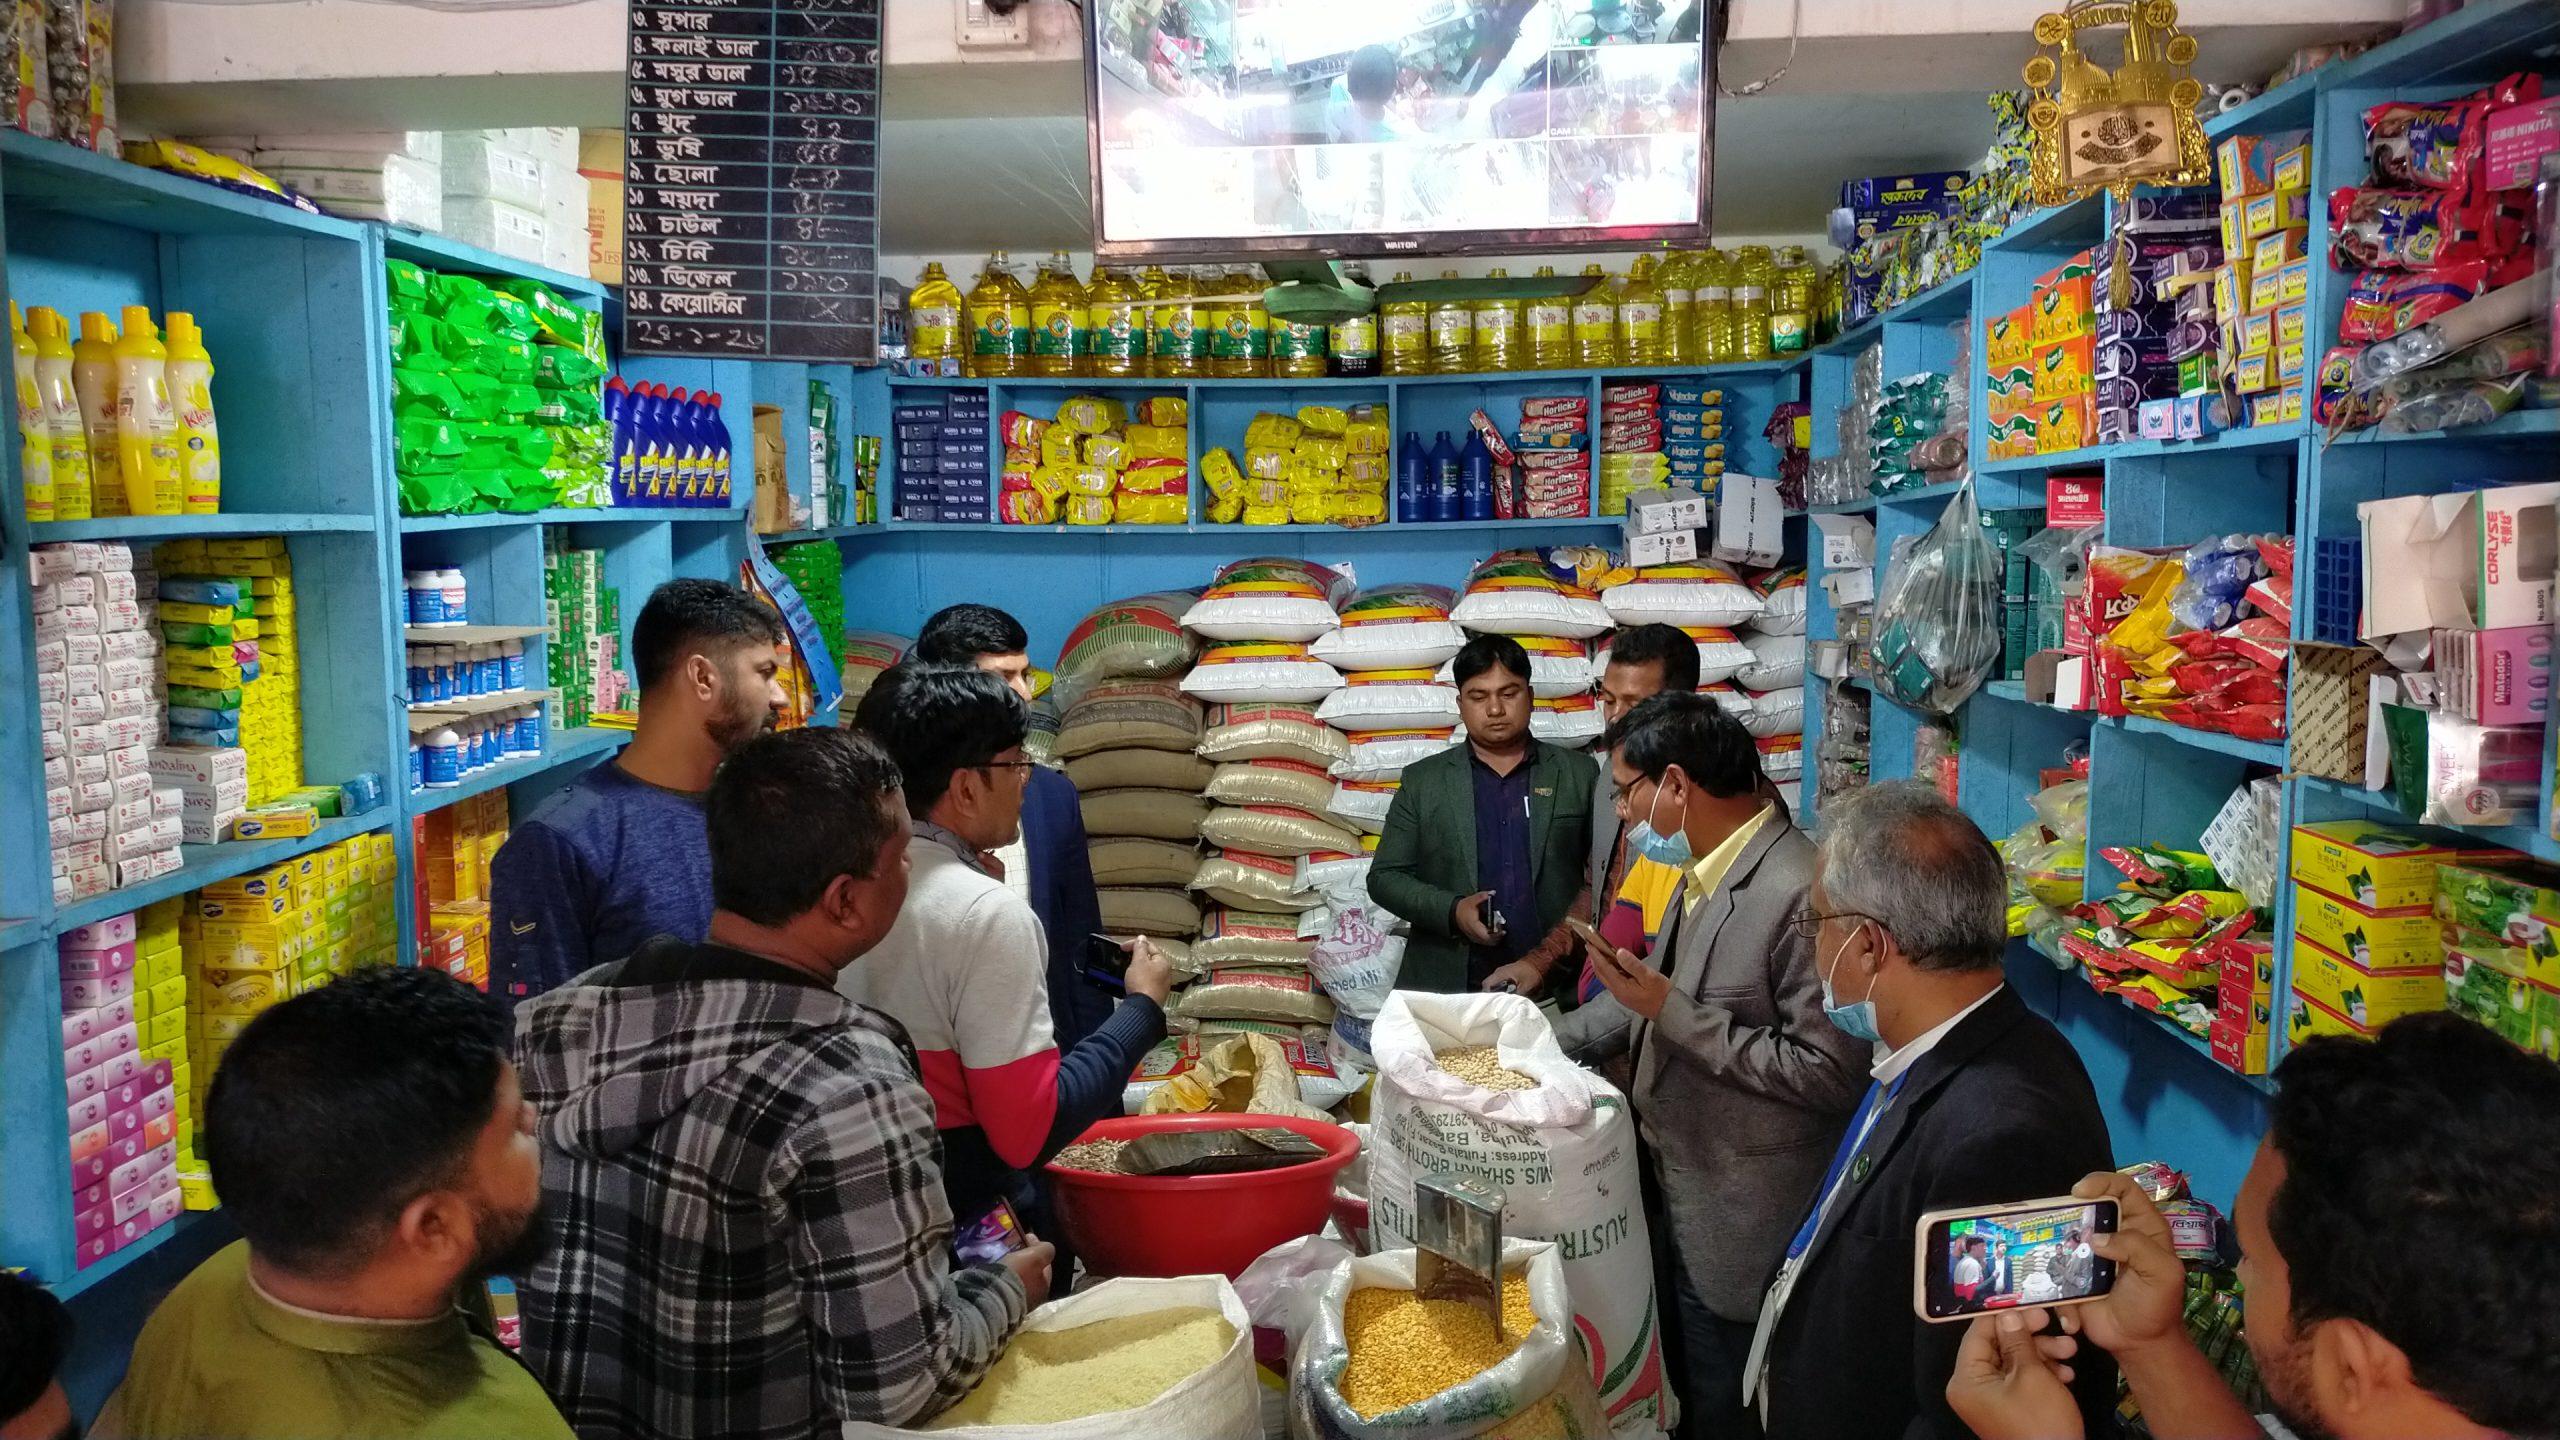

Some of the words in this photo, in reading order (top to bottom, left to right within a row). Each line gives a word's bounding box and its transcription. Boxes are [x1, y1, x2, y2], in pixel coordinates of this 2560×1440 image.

[657, 11, 713, 32] সুপার
[651, 35, 713, 58] কলাই
[716, 39, 759, 57] ডাল
[653, 62, 703, 83] মসুর
[707, 64, 751, 82] ডাল
[654, 88, 691, 109] মুগ
[694, 90, 737, 108] ডাল
[657, 113, 696, 134] খুদ
[2516, 118, 2553, 137] NIKITA
[656, 137, 704, 161] ভুষি
[654, 165, 720, 184] ছোলা
[657, 190, 720, 210] ময়দা
[658, 213, 722, 235] চাউল
[660, 239, 714, 262] চিনি
[660, 265, 737, 289] ডিজেল
[660, 291, 747, 315] কেরোসিন
[1614, 387, 1647, 402] Horlicks
[1544, 401, 1577, 416] Horlicks
[1614, 409, 1647, 422] Horlicks
[1541, 421, 1573, 434] Horlicks
[1619, 423, 1651, 437] Horlicks
[1615, 437, 1647, 451] Horlicks
[1545, 453, 1578, 468] Horlicks
[1545, 473, 1578, 486] Horlicks
[1544, 486, 1577, 501] Horlicks
[1545, 503, 1579, 518] Horlicks
[2486, 510, 2499, 585] CORLYSE
[2494, 652, 2505, 703] Matador
[149, 757, 197, 773] andalina
[214, 751, 245, 768] Sandalina
[2440, 745, 2456, 796] SWEET
[1491, 1151, 1546, 1163] Address:
[1520, 1166, 1553, 1185] M/S.
[1381, 1197, 1418, 1246] TILS
